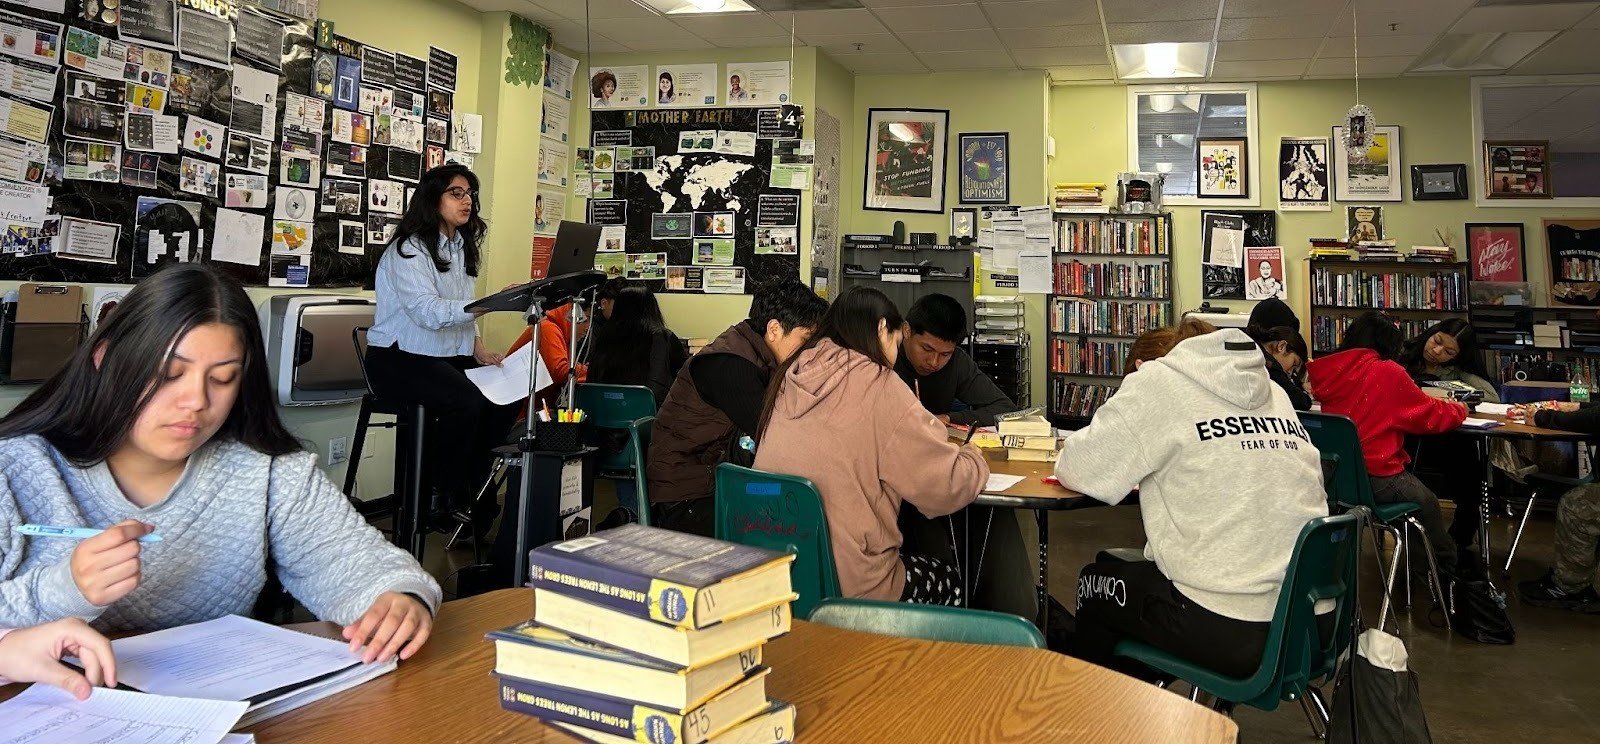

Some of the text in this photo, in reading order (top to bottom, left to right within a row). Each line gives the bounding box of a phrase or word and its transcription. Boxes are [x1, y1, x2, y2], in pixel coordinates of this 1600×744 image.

[638, 109, 733, 124] MOTHER EARTH
[784, 110, 796, 126] 4
[884, 166, 931, 181] STOP FUNDING
[965, 189, 1003, 198] OPTIMISM
[1479, 237, 1513, 264] Stay
[1480, 257, 1515, 277] Woke!
[1570, 387, 1588, 395] Sprite
[1241, 440, 1298, 450] FEAR OF GOD
[544, 570, 560, 582] GROW
[561, 575, 579, 587] TREES
[579, 578, 599, 592] LEMON
[599, 583, 610, 595] THE
[610, 586, 619, 597] AS
[620, 588, 636, 601] LONG
[636, 592, 646, 603] AS
[771, 605, 782, 628] 18
[517, 692, 535, 705] GROW
[535, 697, 555, 711] TREES
[556, 702, 577, 716] LEMON
[578, 707, 590, 720] THE
[591, 711, 600, 722] AS
[601, 714, 619, 726] LONG
[688, 707, 711, 737] 45
[619, 718, 629, 729] AS
